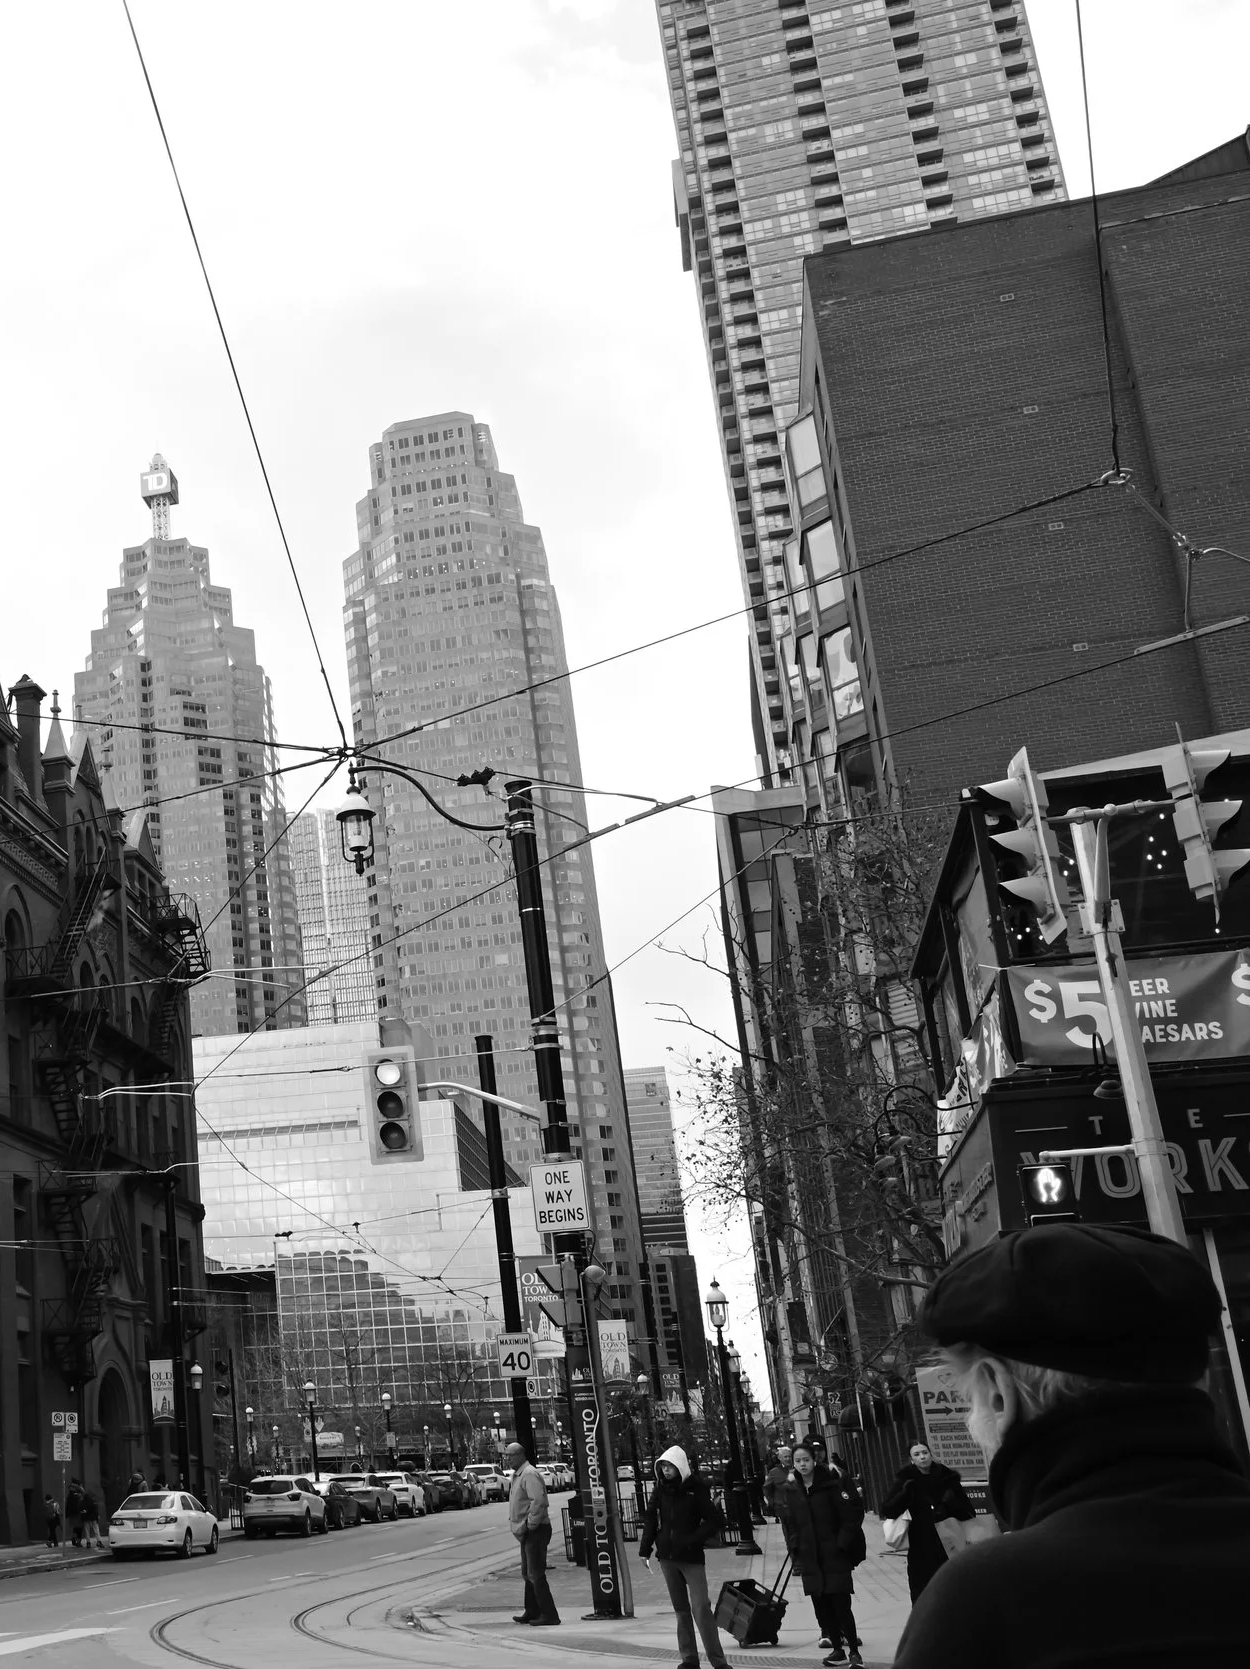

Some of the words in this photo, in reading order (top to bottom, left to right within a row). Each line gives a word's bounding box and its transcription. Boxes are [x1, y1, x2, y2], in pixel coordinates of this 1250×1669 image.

[142, 472, 168, 490] TD
[1128, 978, 1170, 996] EER
[1024, 979, 1113, 1049] $5
[1142, 1022, 1224, 1042] AESARS
[1088, 1108, 1203, 1135] TE
[544, 1171, 570, 1185] ONE
[545, 1189, 572, 1204] WAY
[539, 1208, 584, 1224] BEGINS
[522, 1272, 545, 1286] OL
[522, 1286, 552, 1295] TOW
[601, 1333, 625, 1341] OLD
[502, 1351, 530, 1371] 40
[152, 1372, 172, 1380] OLD
[923, 1390, 972, 1404] PAR
[582, 1408, 600, 1488] TORONTO
[598, 1552, 614, 1594] OLD
